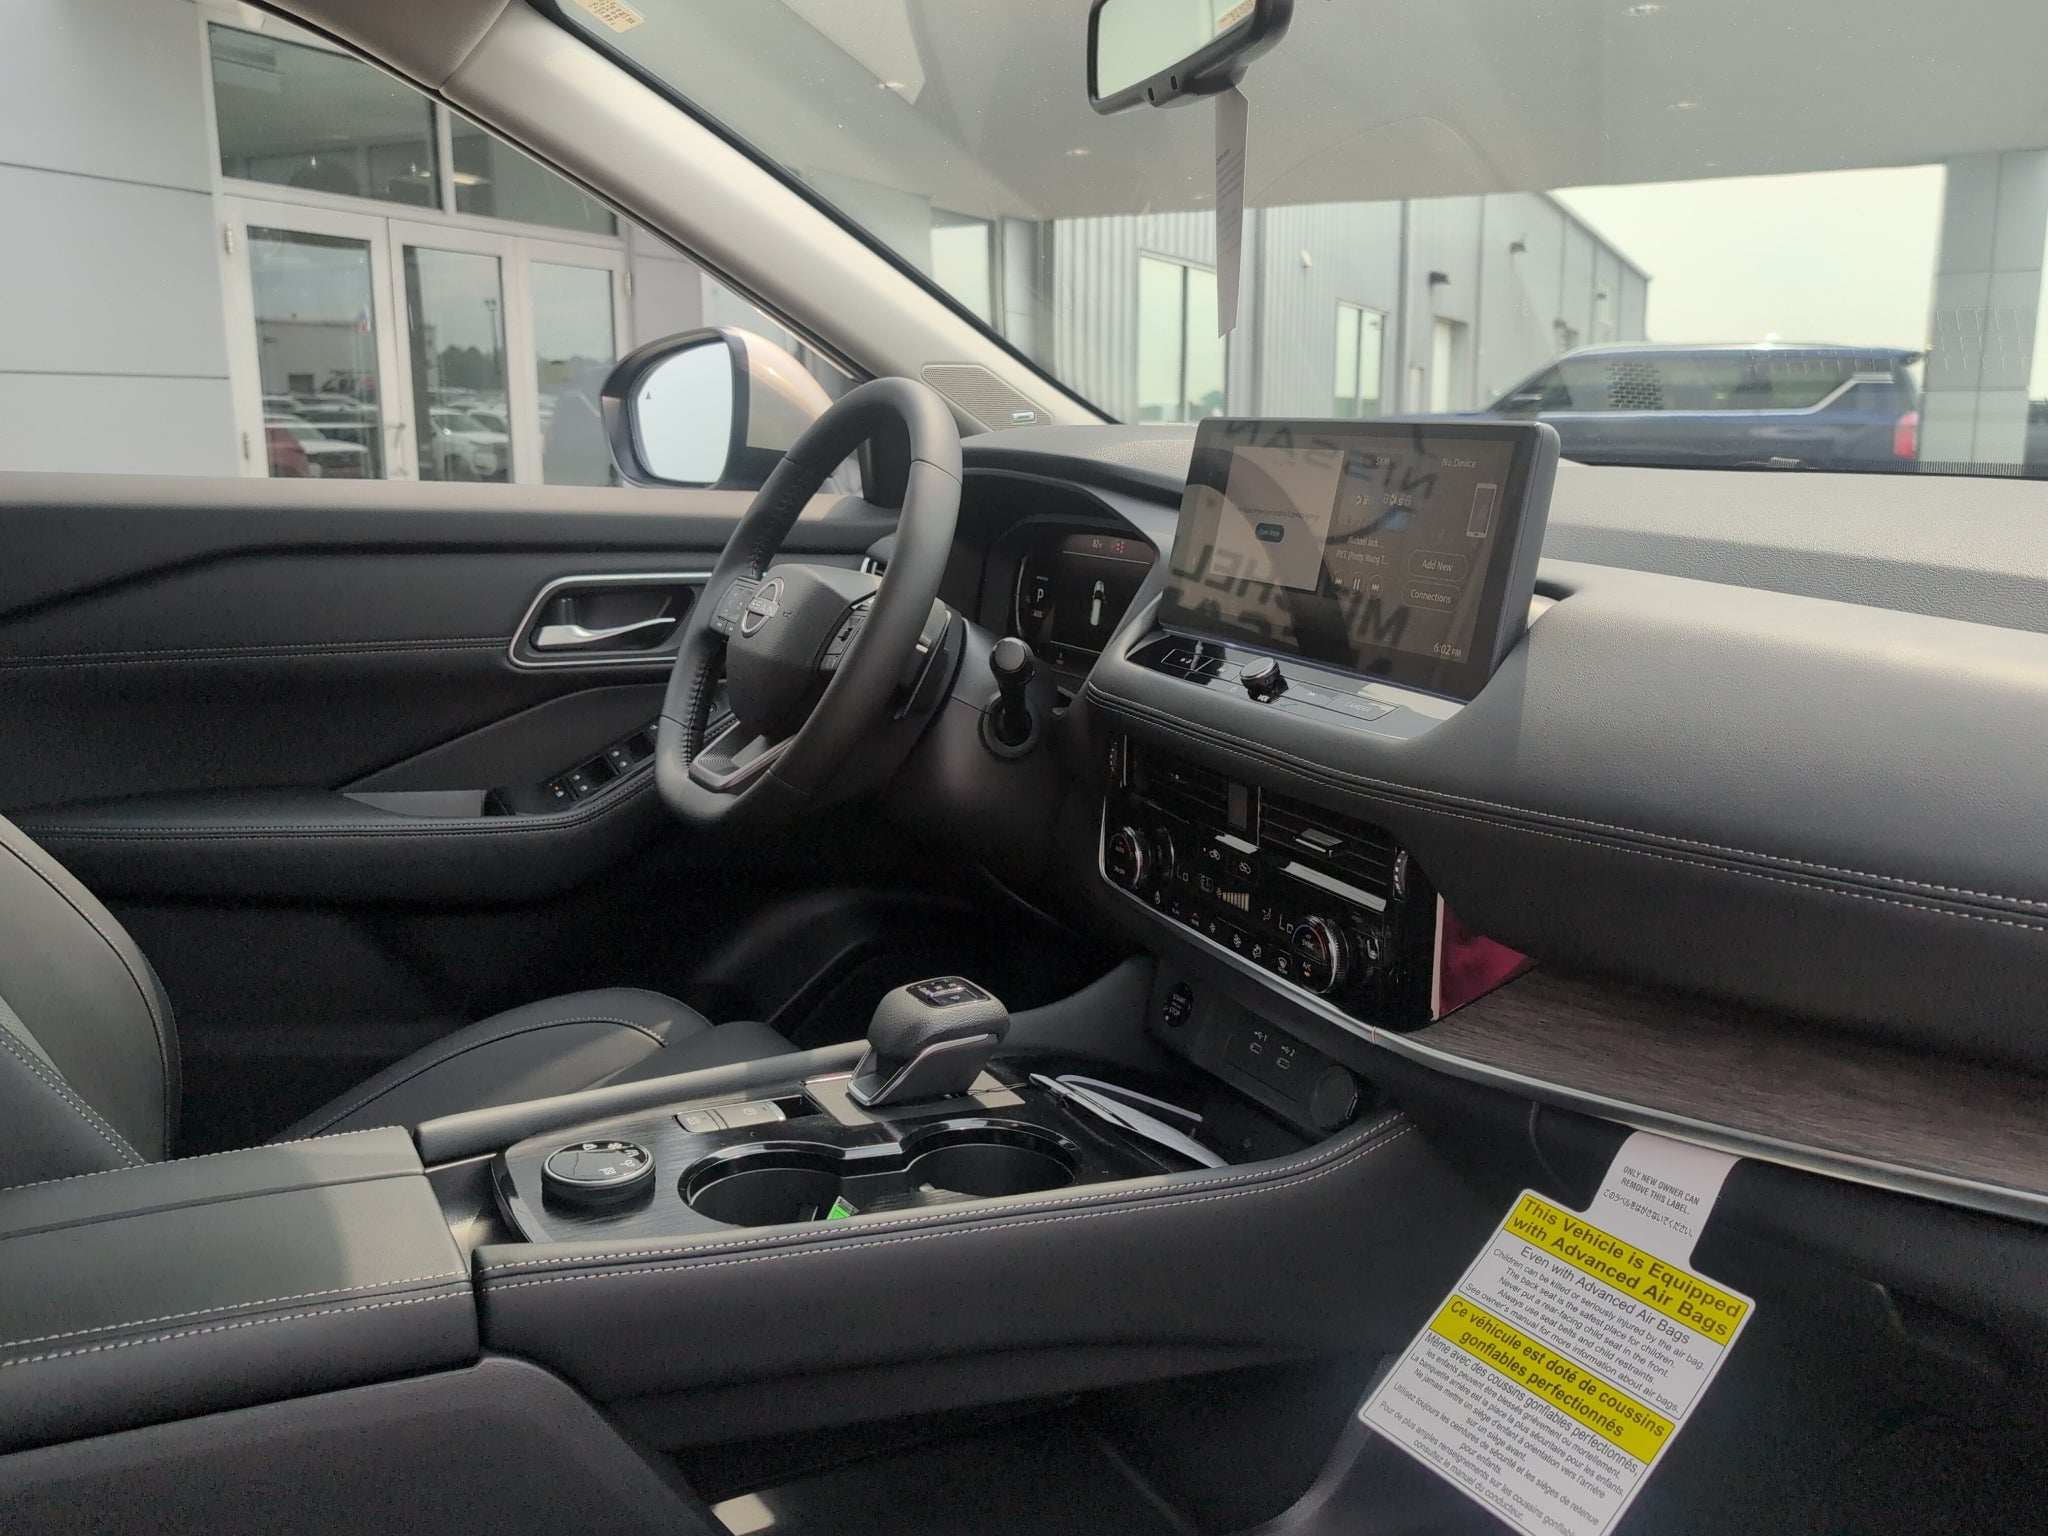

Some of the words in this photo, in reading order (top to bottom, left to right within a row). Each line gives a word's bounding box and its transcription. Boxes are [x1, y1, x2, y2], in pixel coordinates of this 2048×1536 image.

[1442, 458, 1452, 468] No
[1453, 457, 1477, 469] Device
[1410, 589, 1452, 604] Connections
[1421, 559, 1436, 571] Add
[1437, 561, 1454, 573] New
[1433, 642, 1451, 656] 6:02
[1452, 648, 1462, 658] PM
[1621, 1177, 1650, 1197] REMOVE
[1650, 1189, 1667, 1204] THIS
[1667, 1198, 1690, 1216] LABEL.
[1623, 1165, 1642, 1179] ONLY
[1641, 1173, 1658, 1187] NEW
[1658, 1181, 1684, 1200] OWNER
[1684, 1192, 1701, 1207] CAN
[1493, 1248, 1524, 1270] Children
[1523, 1266, 1538, 1278] can
[1538, 1272, 1550, 1284] be
[1549, 1278, 1572, 1295] killed
[1570, 1292, 1581, 1301] or
[1580, 1297, 1617, 1321] seriously
[1615, 1315, 1646, 1337] injured
[1645, 1331, 1658, 1344] by
[1657, 1338, 1672, 1351] the
[1672, 1348, 1686, 1358] air
[1685, 1353, 1704, 1370] bag.
[1513, 1217, 1547, 1242] with
[1550, 1236, 1641, 1290] Advanced
[1642, 1284, 1674, 1306] Air
[1676, 1299, 1728, 1336] Bags
[1520, 1245, 1550, 1269] Even
[1551, 1263, 1575, 1282] with
[1574, 1276, 1637, 1315] Advanced
[1635, 1308, 1656, 1325] Air
[1656, 1318, 1690, 1344] Bags
[1524, 1198, 1558, 1225] This
[1563, 1217, 1624, 1259] Vehicle
[1627, 1251, 1644, 1269] is
[1647, 1262, 1742, 1318] Equipped
[1465, 1282, 1481, 1296] See
[1481, 1293, 1510, 1313] owner's
[1509, 1309, 1540, 1330] manual
[1538, 1324, 1551, 1336] for
[1550, 1333, 1572, 1349] more
[1571, 1343, 1617, 1376] information
[1617, 1372, 1643, 1391] about
[1642, 1387, 1656, 1398] air
[1655, 1392, 1678, 1414] bags.
[1496, 1288, 1524, 1308] Always
[1524, 1304, 1540, 1317] use
[1539, 1313, 1558, 1328] seat
[1557, 1322, 1577, 1339] belts
[1577, 1335, 1596, 1349] and
[1594, 1345, 1616, 1360] child
[1614, 1356, 1654, 1385] restraints.
[1498, 1275, 1522, 1295] Never
[1519, 1290, 1536, 1302] put
[1540, 1301, 1583, 1330] rear-facing
[1583, 1325, 1604, 1341] child
[1603, 1336, 1623, 1352] seat
[1621, 1345, 1632, 1357] in
[1631, 1351, 1649, 1365] the
[1646, 1359, 1668, 1379] front.
[1505, 1266, 1520, 1280] The
[1519, 1275, 1540, 1291] back
[1538, 1287, 1558, 1301] seat
[1556, 1295, 1565, 1305] is
[1565, 1300, 1579, 1313] the
[1578, 1309, 1605, 1328] safest
[1602, 1323, 1627, 1340] place
[1627, 1335, 1641, 1347] for
[1640, 1344, 1675, 1368] children.
[1424, 1331, 1451, 1354] Même
[1449, 1349, 1472, 1367] avec
[1470, 1361, 1488, 1377] des
[1486, 1372, 1526, 1402] coussins
[1522, 1396, 1573, 1432] gonflables
[1569, 1426, 1638, 1477] perfectionnés,
[1450, 1300, 1468, 1317] Ce
[1469, 1313, 1522, 1350] véhicule
[1522, 1346, 1546, 1365] est
[1545, 1359, 1578, 1383] doté
[1577, 1378, 1597, 1396] de
[1598, 1392, 1665, 1437] coussins
[1458, 1331, 1527, 1377] gonflables
[1525, 1372, 1624, 1437] perfectionnés
